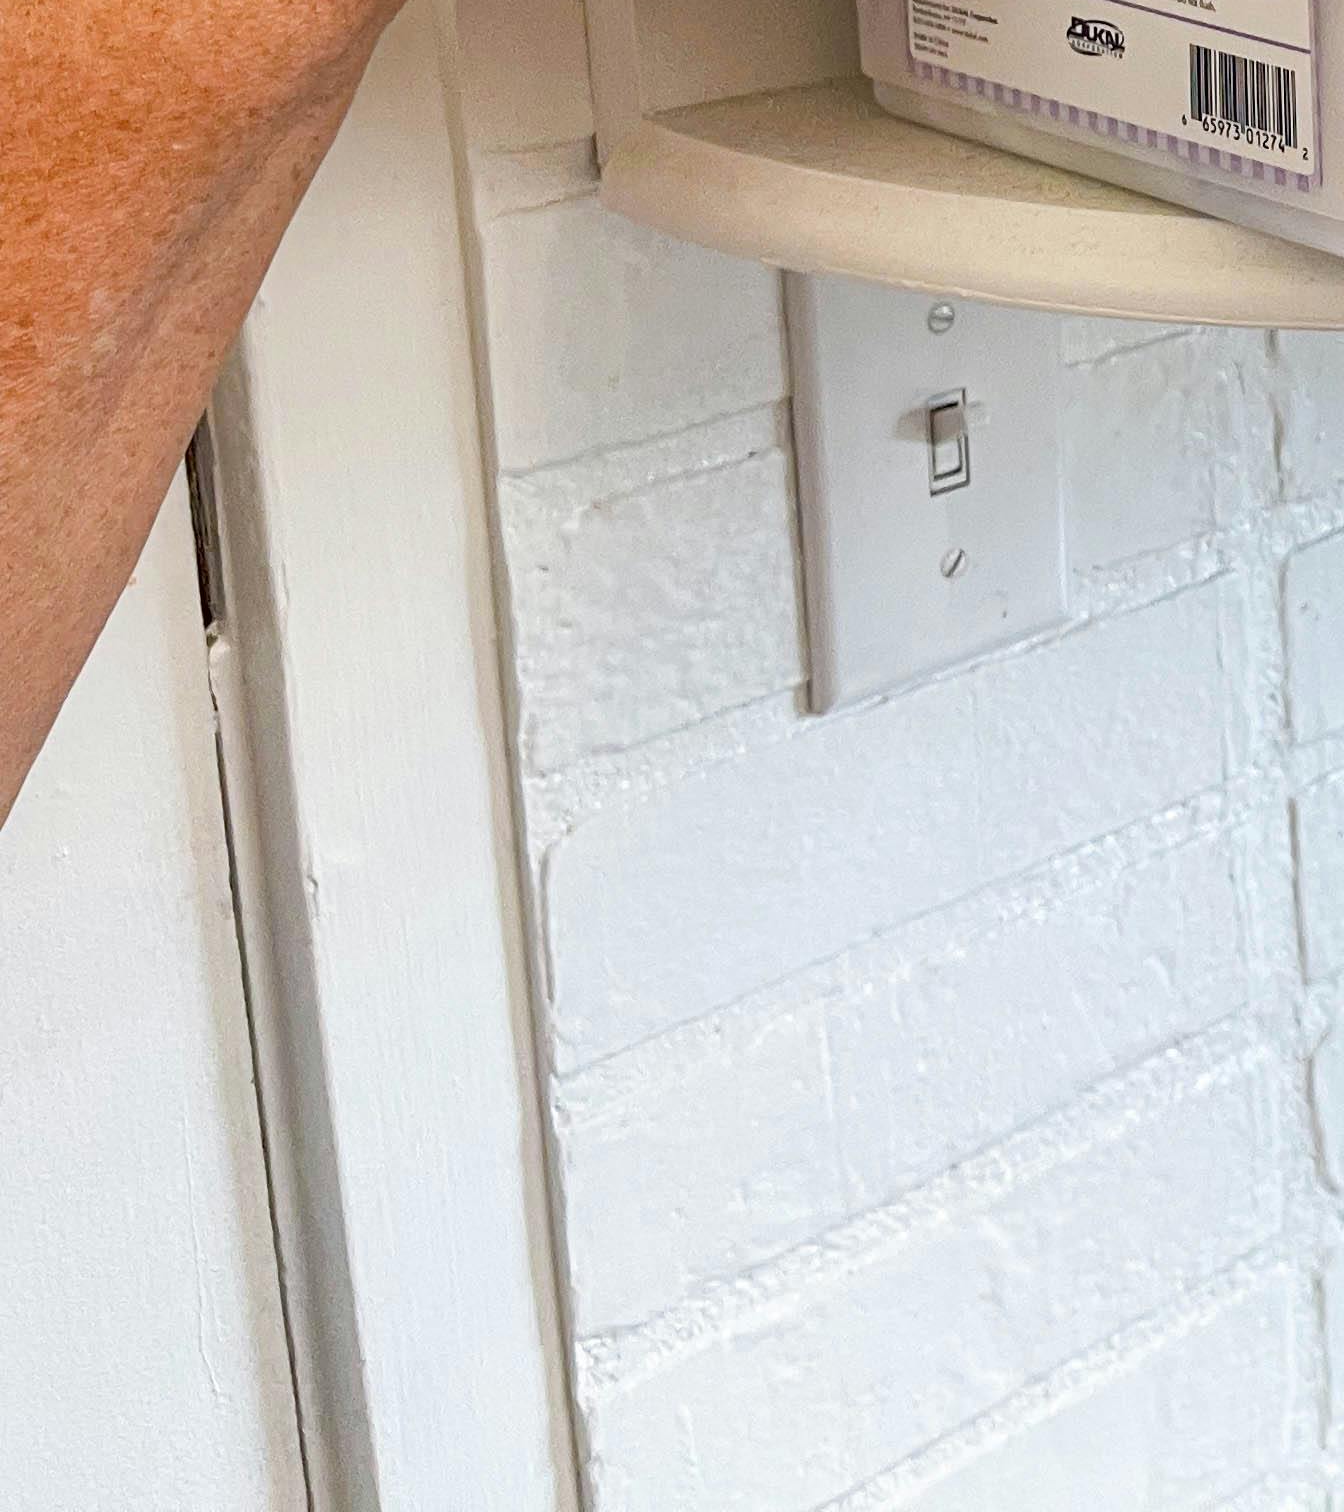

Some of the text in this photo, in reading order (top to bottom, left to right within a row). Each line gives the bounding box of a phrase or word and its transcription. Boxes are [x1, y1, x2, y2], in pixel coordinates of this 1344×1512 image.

[1201, 115, 1241, 141] 65973
[1245, 127, 1286, 153] 01274
[1302, 147, 1309, 161] 2
